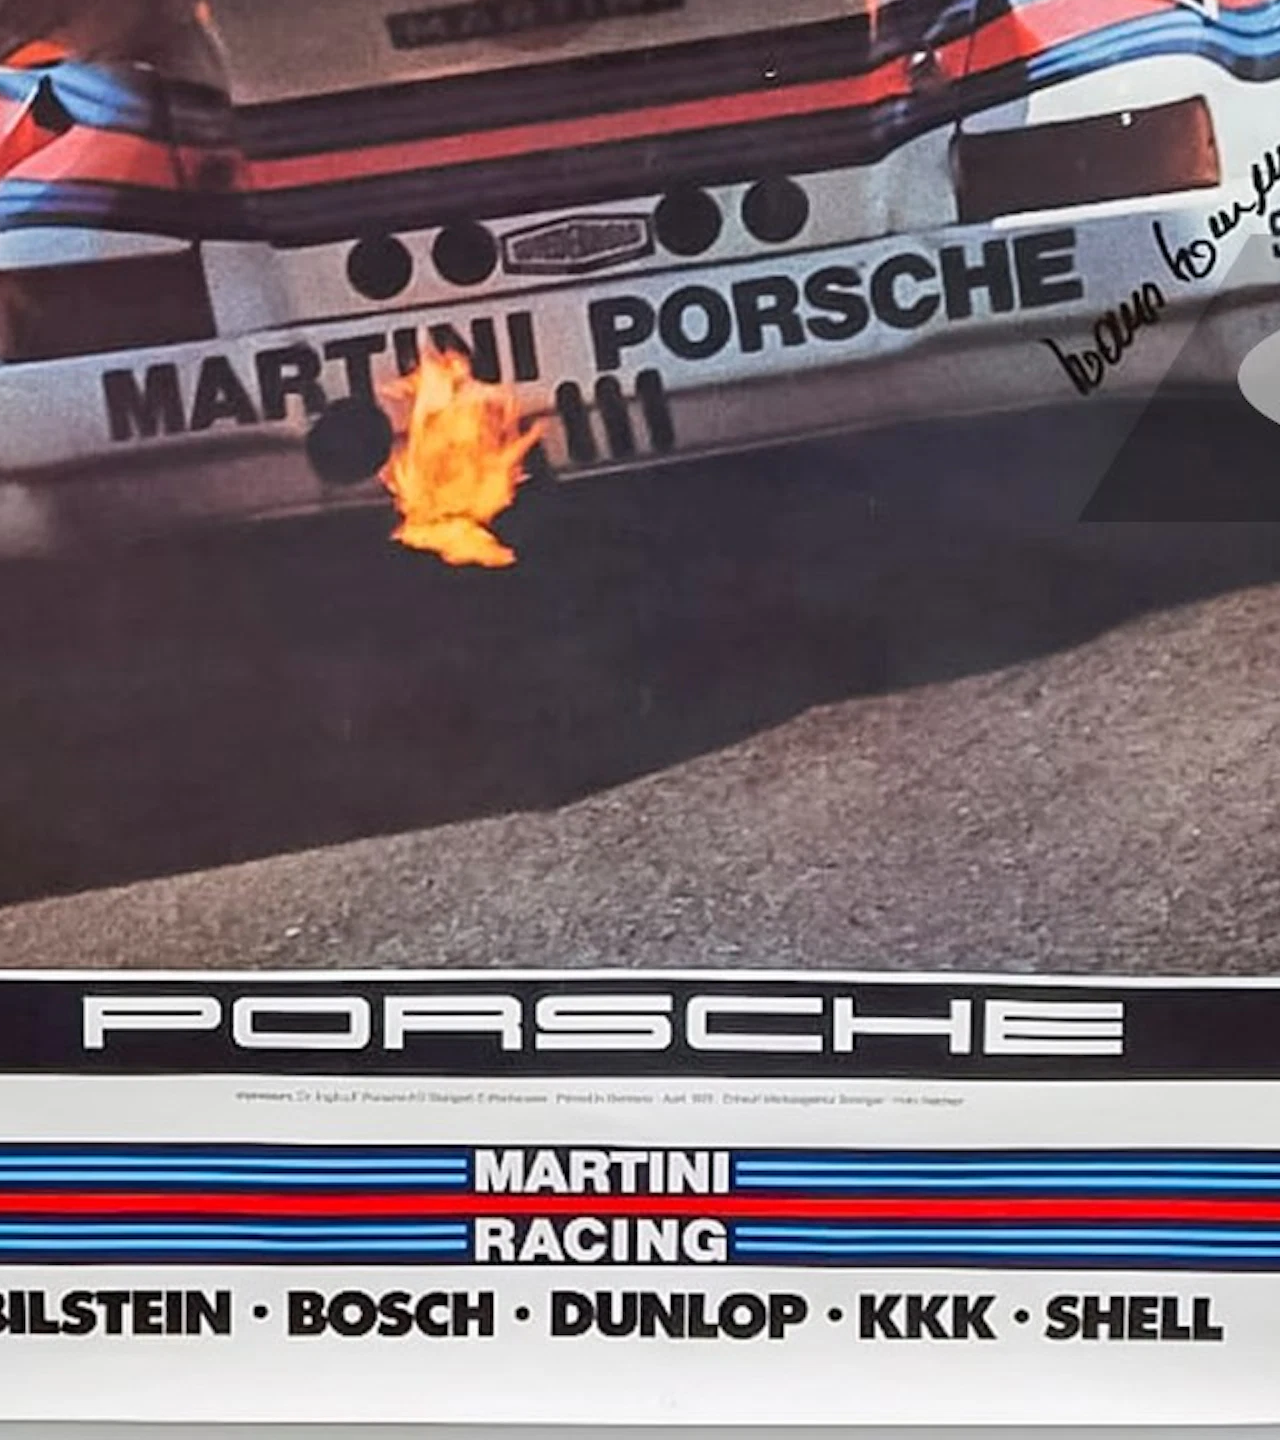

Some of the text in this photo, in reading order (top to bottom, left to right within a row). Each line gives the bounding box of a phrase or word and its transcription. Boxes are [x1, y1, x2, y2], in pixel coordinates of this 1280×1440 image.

[102, 229, 1083, 442] MARTINI PORSCHE
[81, 995, 1125, 1056] PORSCHE
[475, 1149, 730, 1196] MARTINI
[475, 1217, 730, 1264] RACING
[287, 1291, 496, 1338] BOSCH
[551, 1291, 808, 1340] DUNLOP
[859, 1294, 997, 1340] KKK
[1044, 1294, 1224, 1340] SHELL
